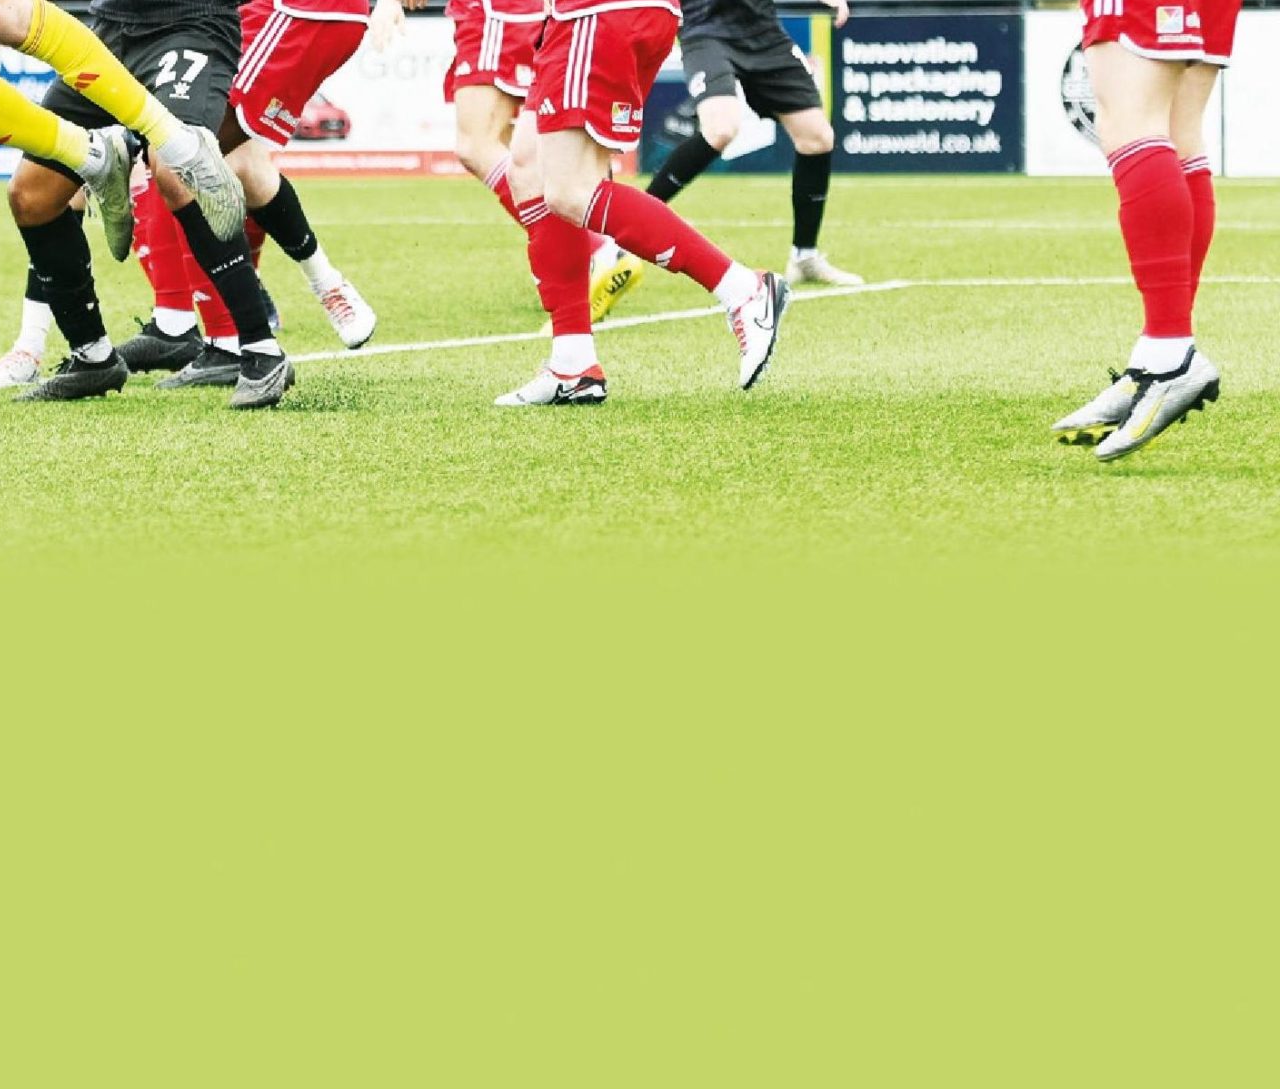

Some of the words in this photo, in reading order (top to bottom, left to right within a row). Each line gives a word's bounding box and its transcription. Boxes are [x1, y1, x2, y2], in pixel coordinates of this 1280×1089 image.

[842, 36, 978, 64] Innovation
[156, 49, 208, 88] 27
[871, 65, 1002, 97] packaging
[842, 95, 867, 122] &
[869, 94, 996, 126] stationery
